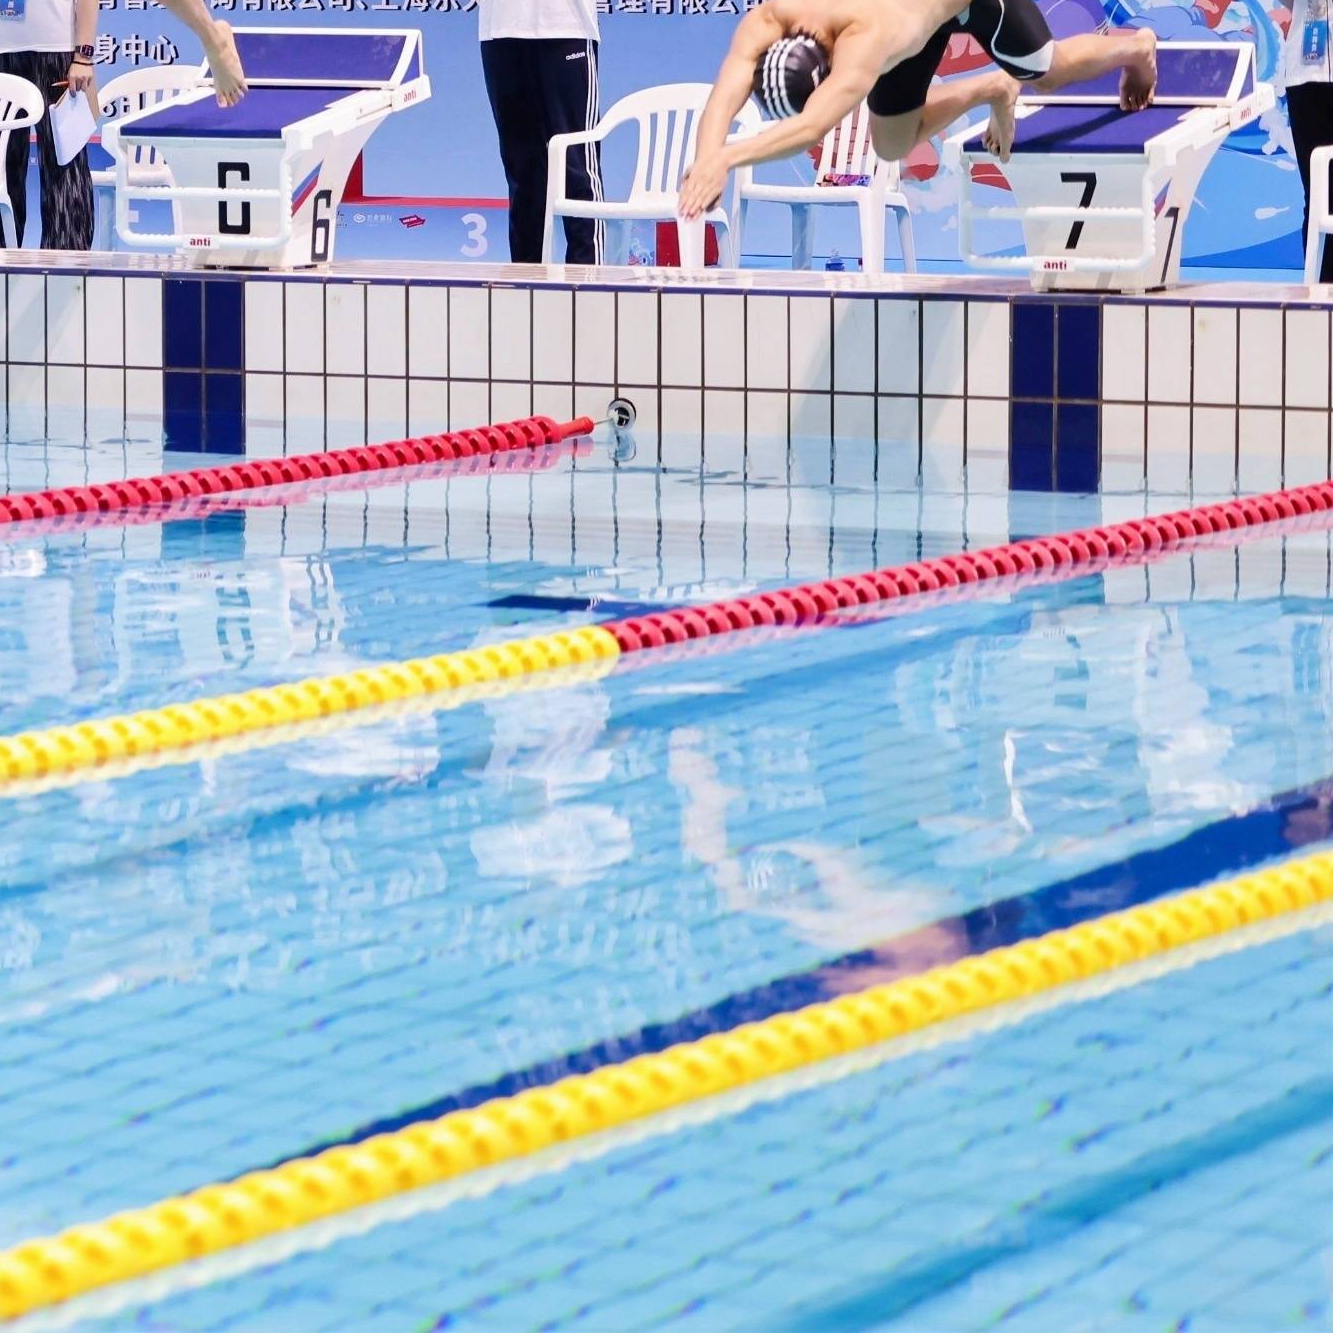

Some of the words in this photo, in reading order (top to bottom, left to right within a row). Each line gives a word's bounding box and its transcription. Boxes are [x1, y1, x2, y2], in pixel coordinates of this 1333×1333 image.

[565, 51, 586, 62] adidas
[403, 89, 418, 103] anti
[1060, 171, 1098, 250] 7
[310, 188, 332, 262] 6
[189, 236, 212, 247] anti
[460, 213, 489, 258] 3
[1043, 260, 1067, 271] anti
